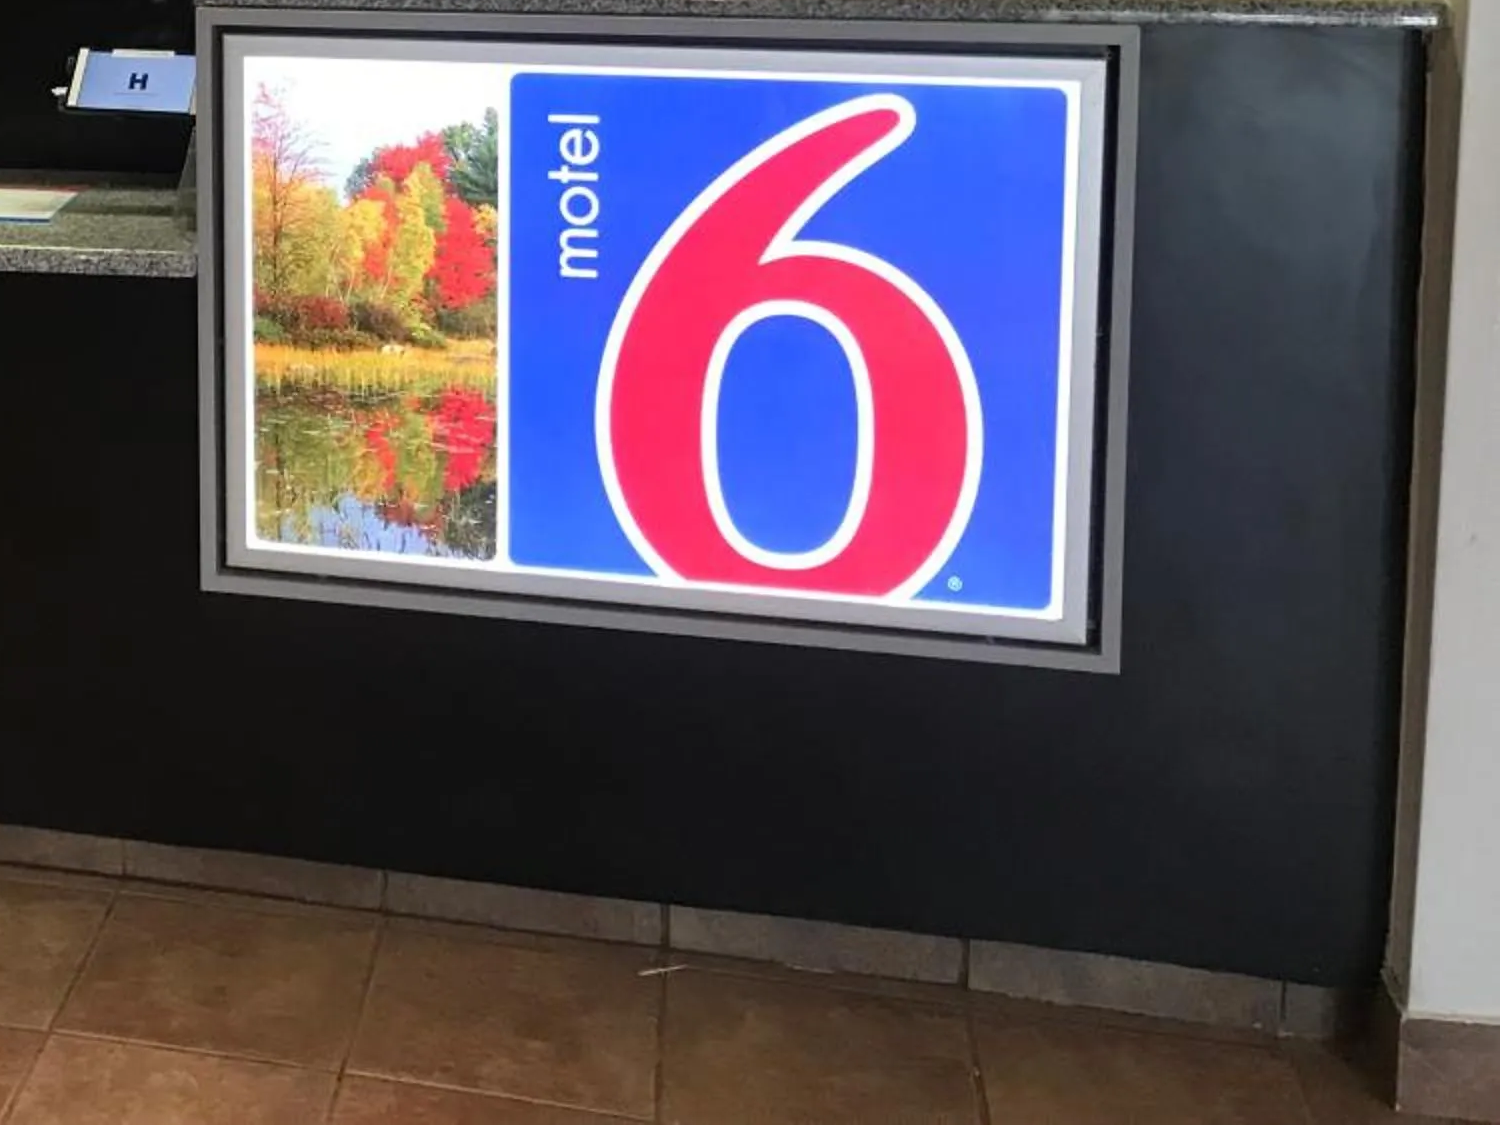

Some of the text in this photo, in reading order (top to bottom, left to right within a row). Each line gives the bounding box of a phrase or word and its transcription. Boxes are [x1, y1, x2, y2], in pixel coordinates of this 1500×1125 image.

[128, 72, 149, 90] H
[547, 92, 983, 602] motel 6
